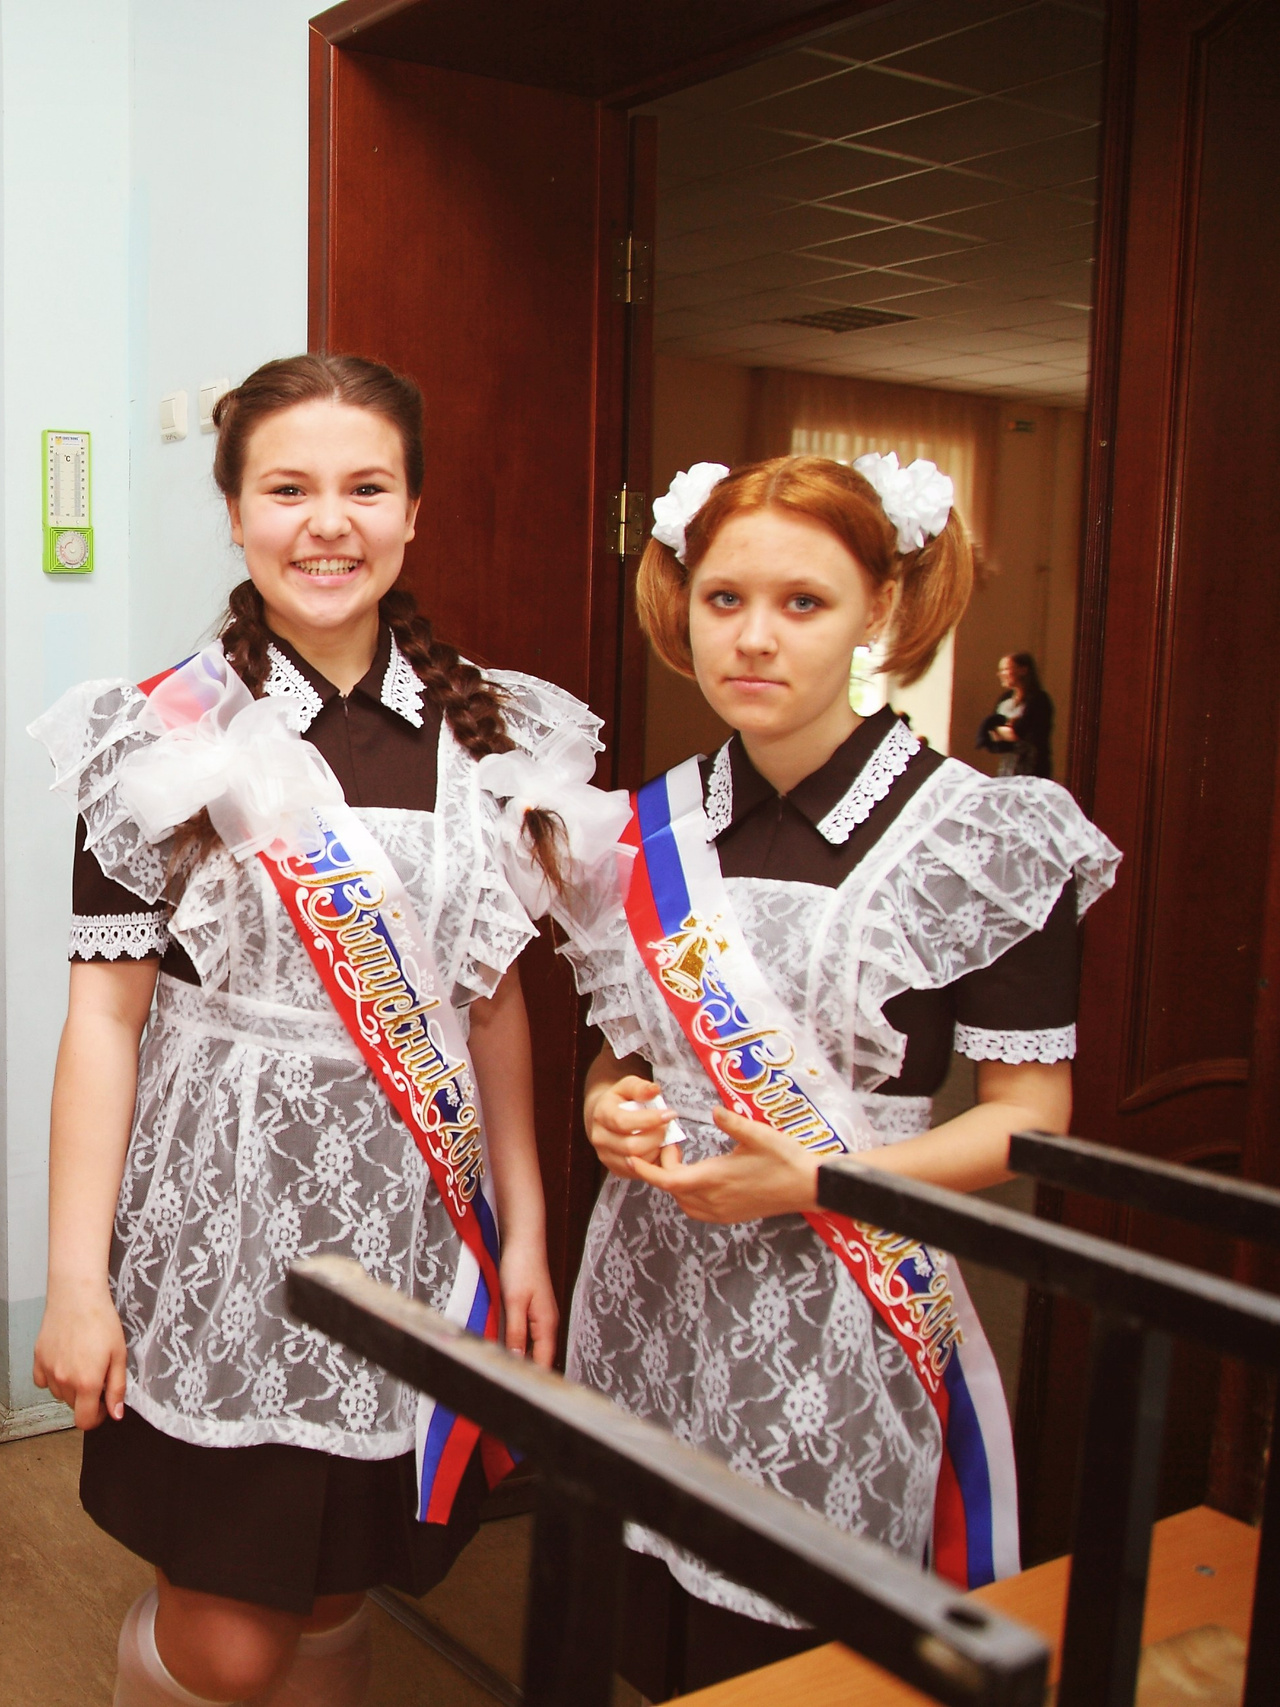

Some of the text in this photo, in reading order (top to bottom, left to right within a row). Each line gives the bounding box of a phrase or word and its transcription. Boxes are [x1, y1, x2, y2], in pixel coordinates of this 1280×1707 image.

[277, 843, 486, 1203] Выпускник 2015
[904, 1271, 965, 1377] 2015
